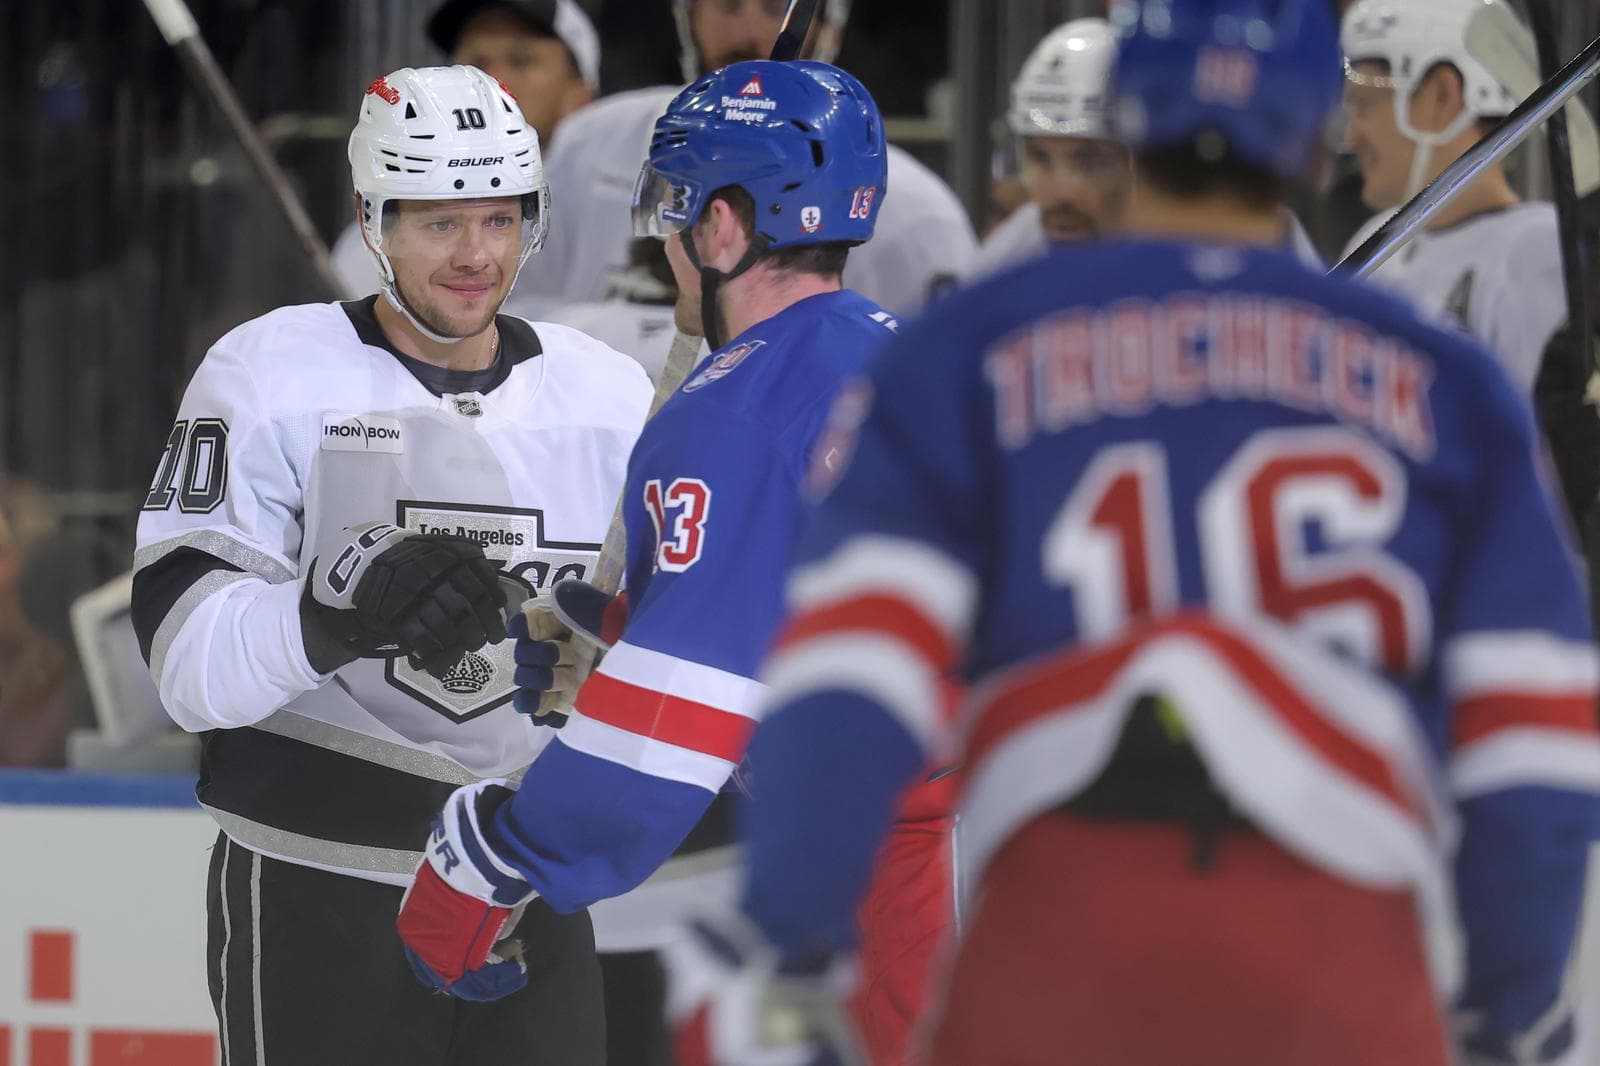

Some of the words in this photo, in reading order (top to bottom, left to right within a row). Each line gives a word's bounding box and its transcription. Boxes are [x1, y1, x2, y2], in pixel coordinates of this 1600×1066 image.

[721, 96, 776, 110] Benjamin
[452, 108, 487, 131] 10
[725, 109, 765, 122] Moore
[447, 156, 504, 168] BAUER
[849, 186, 877, 219] 13
[985, 297, 1436, 462] TROCHECK
[324, 425, 361, 437] IRON
[367, 427, 400, 439] BOW
[143, 418, 230, 514] 10
[456, 526, 524, 548] Angeles
[643, 477, 711, 574] 13
[1040, 423, 1434, 688] 16
